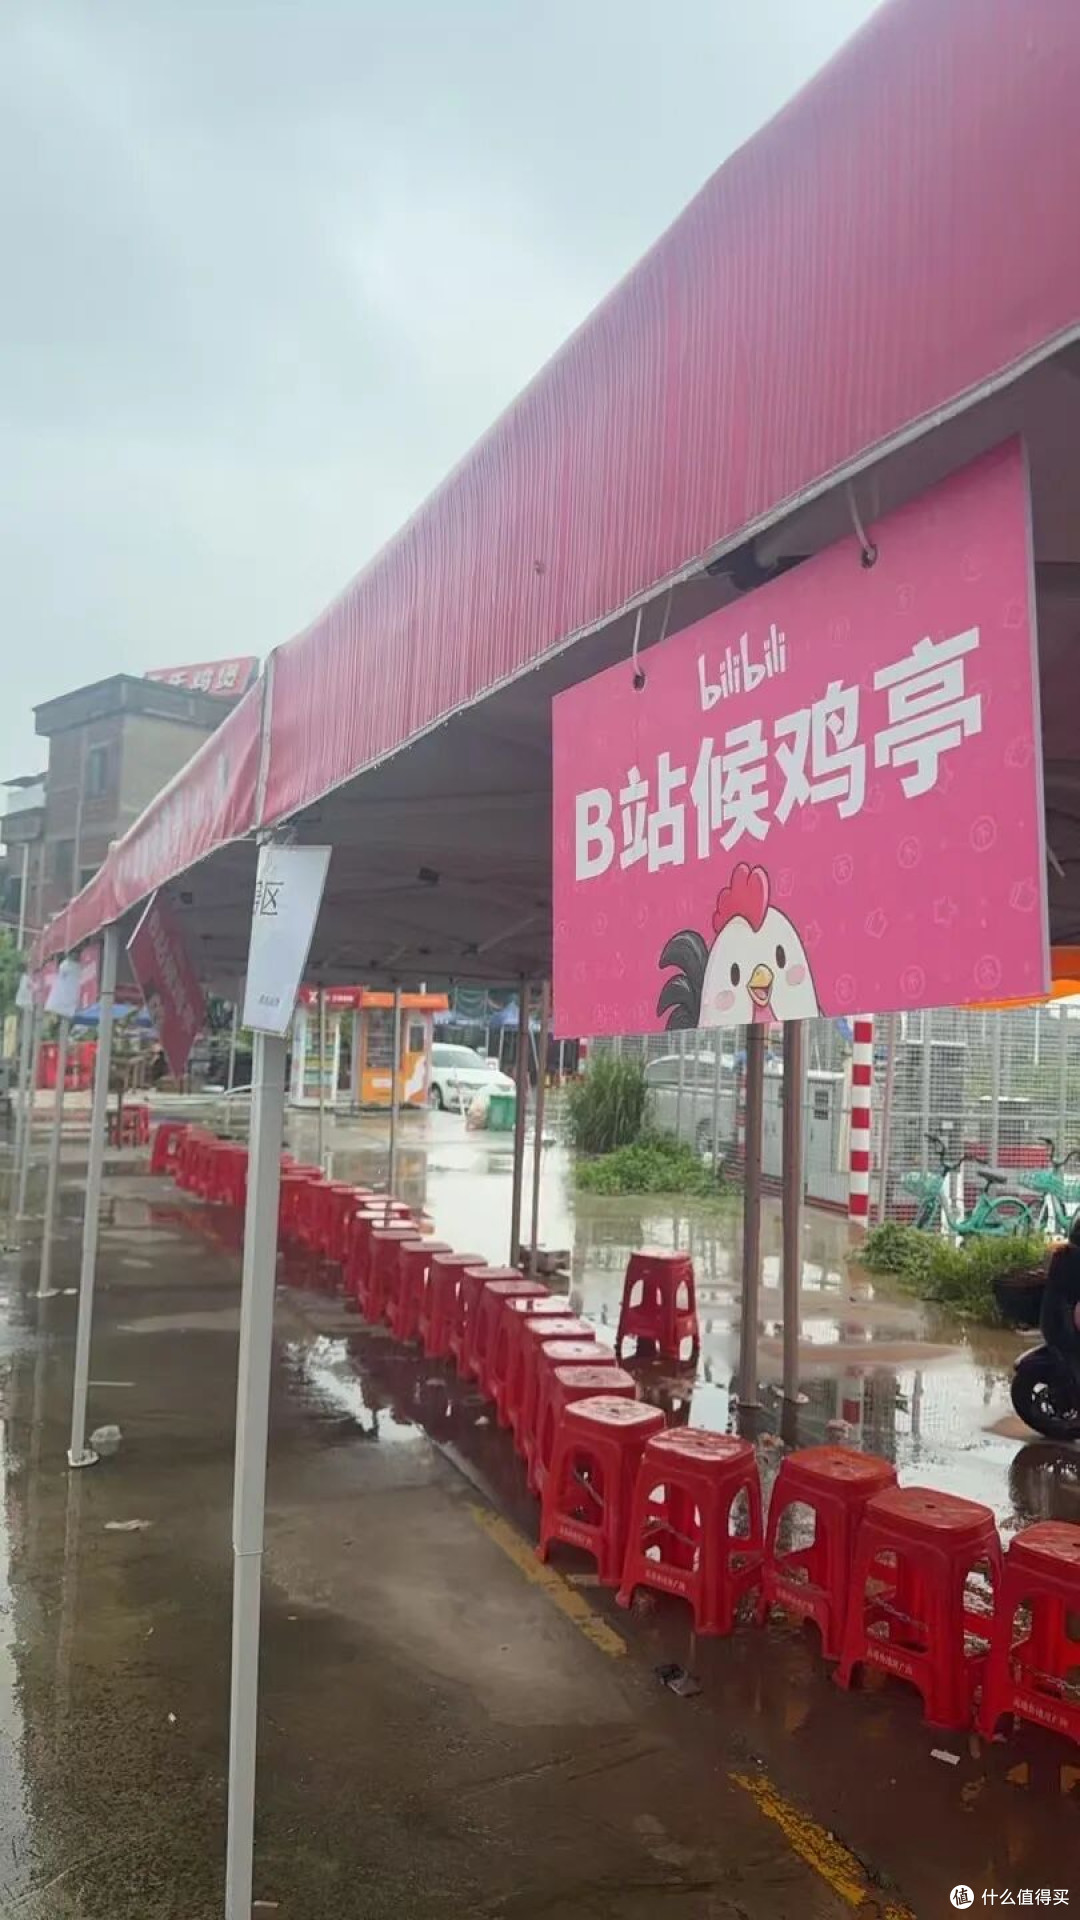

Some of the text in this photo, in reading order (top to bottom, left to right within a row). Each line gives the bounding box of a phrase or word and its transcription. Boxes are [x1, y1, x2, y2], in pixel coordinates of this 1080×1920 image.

[697, 623, 787, 711] bilibili
[575, 626, 982, 882] B站候鸡亭
